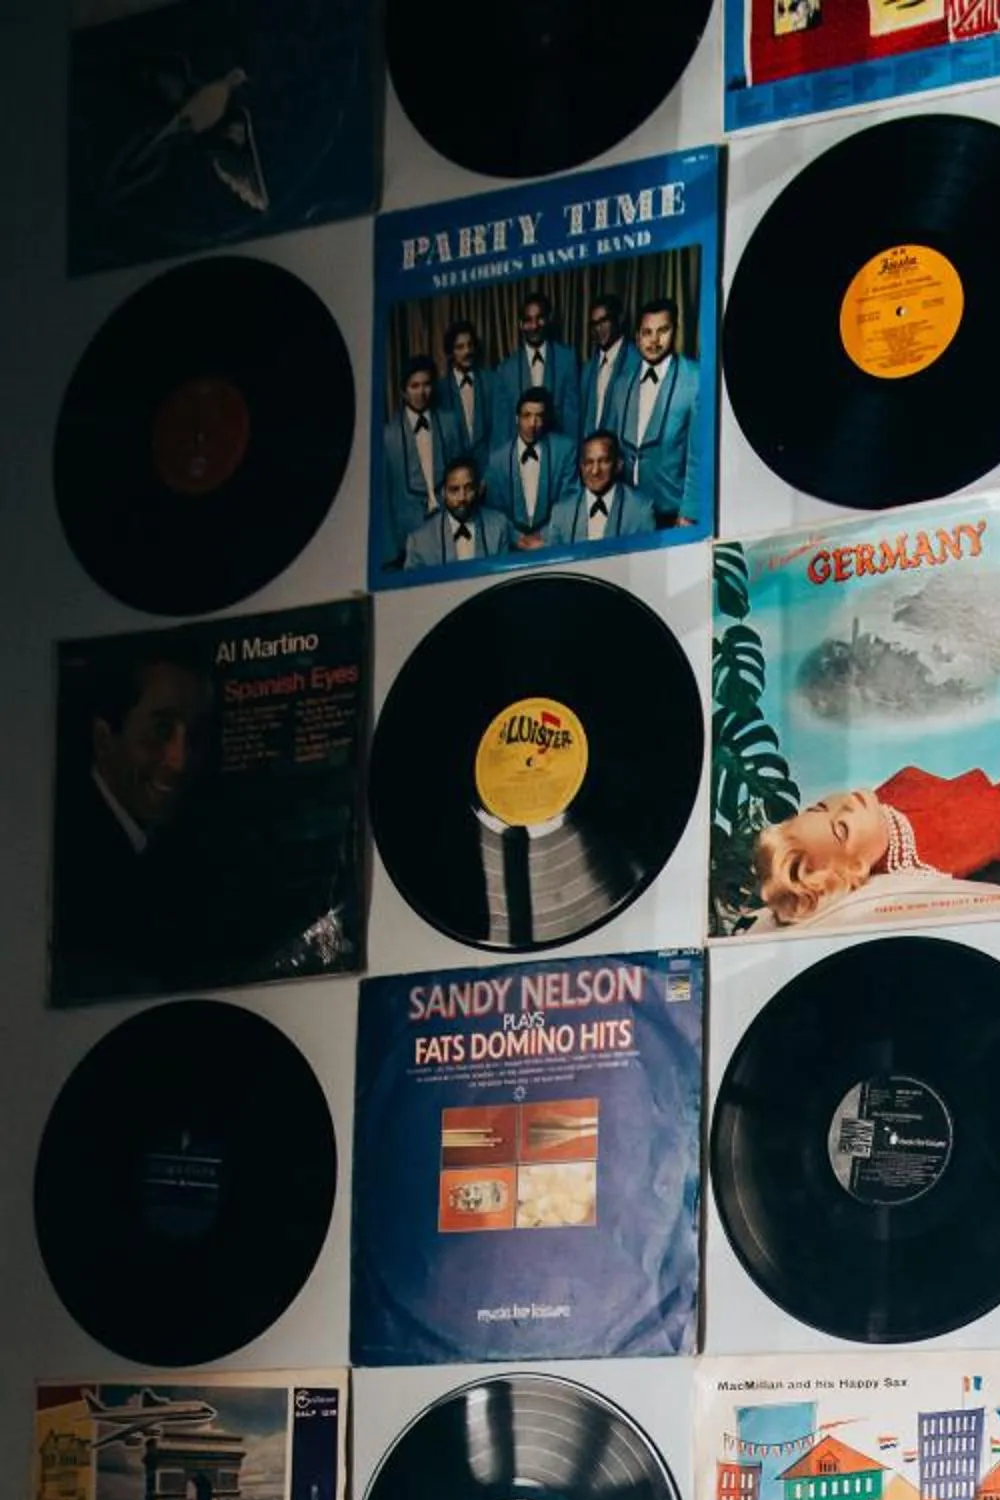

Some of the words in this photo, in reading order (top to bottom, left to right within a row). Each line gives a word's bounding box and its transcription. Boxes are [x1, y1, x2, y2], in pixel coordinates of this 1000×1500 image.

[401, 211, 543, 271] PARTY
[564, 181, 687, 237] TIME
[531, 243, 590, 274] DANCE
[597, 230, 652, 255] BAND
[807, 519, 988, 584] GERMANY
[216, 642, 236, 664] Al
[242, 631, 319, 661] Martino
[224, 672, 305, 702] Spanish
[311, 665, 359, 691] Eyes
[408, 976, 513, 1021] SANDY
[521, 966, 647, 1012] NELSON
[414, 1034, 466, 1065] FATS
[471, 1026, 574, 1060] DOMINO
[580, 1019, 633, 1049] HITS
[503, 1011, 546, 1031] PLAYS
[717, 1380, 783, 1392] MacMillan
[787, 1379, 811, 1390] and
[816, 1379, 835, 1389] his
[840, 1378, 879, 1390] Happy
[884, 1377, 908, 1388] Sax
